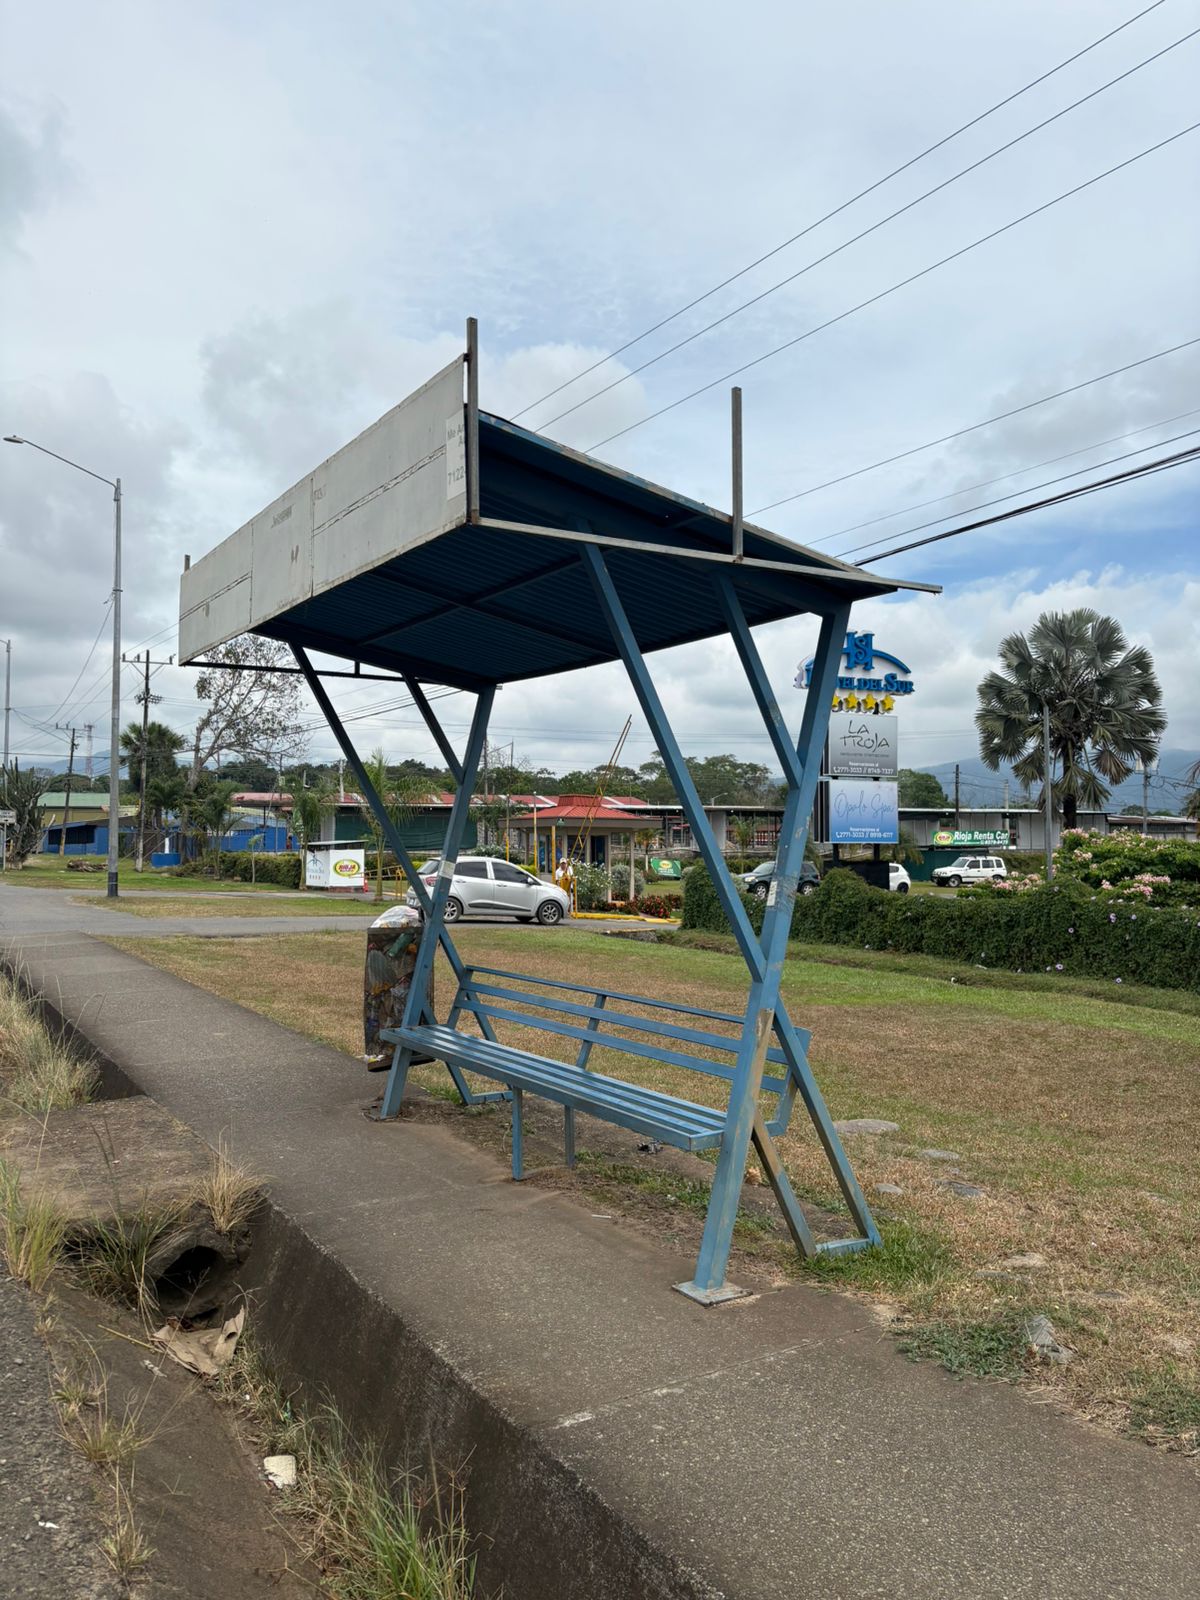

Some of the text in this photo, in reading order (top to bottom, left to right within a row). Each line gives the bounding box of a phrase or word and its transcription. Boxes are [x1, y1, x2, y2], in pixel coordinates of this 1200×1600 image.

[840, 719, 890, 752] LA TROJA
[871, 793, 895, 824] Spa
[954, 831, 972, 842] Rioja
[974, 831, 994, 840] Renta
[995, 830, 1009, 840] Car
